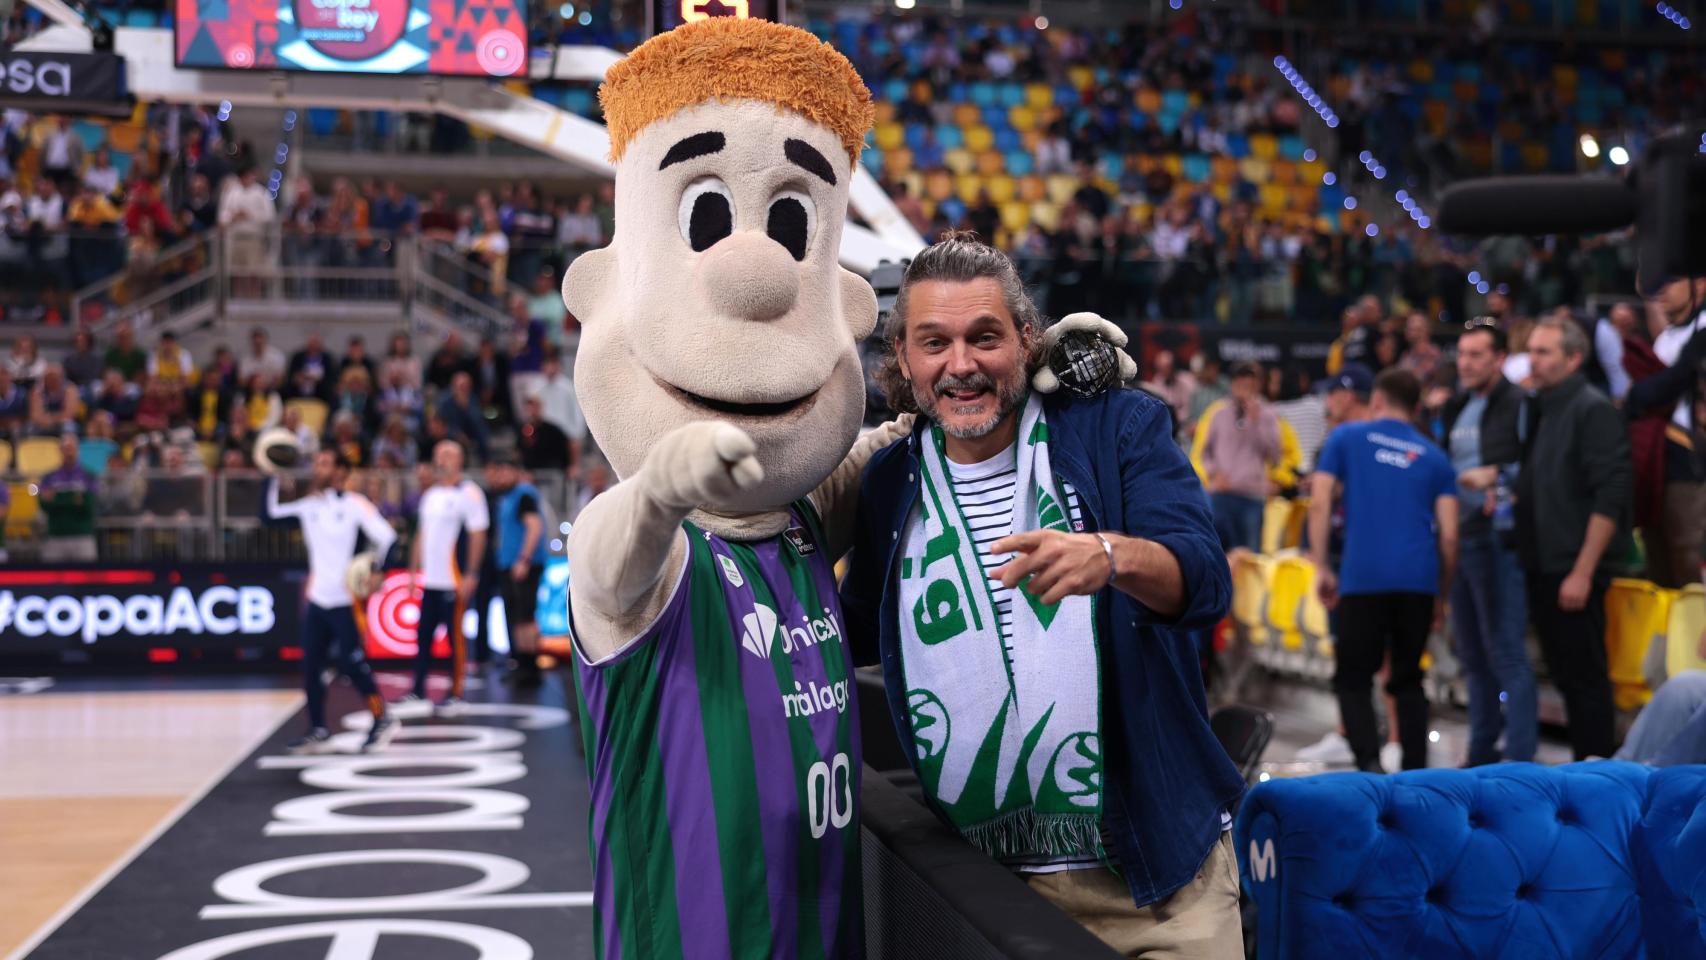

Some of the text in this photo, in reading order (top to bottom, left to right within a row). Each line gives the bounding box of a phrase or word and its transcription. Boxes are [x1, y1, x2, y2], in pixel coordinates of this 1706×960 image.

[0, 59, 71, 96] sa
[779, 607, 842, 654] Unicaj
[782, 679, 849, 718] málag
[807, 752, 853, 839] 00
